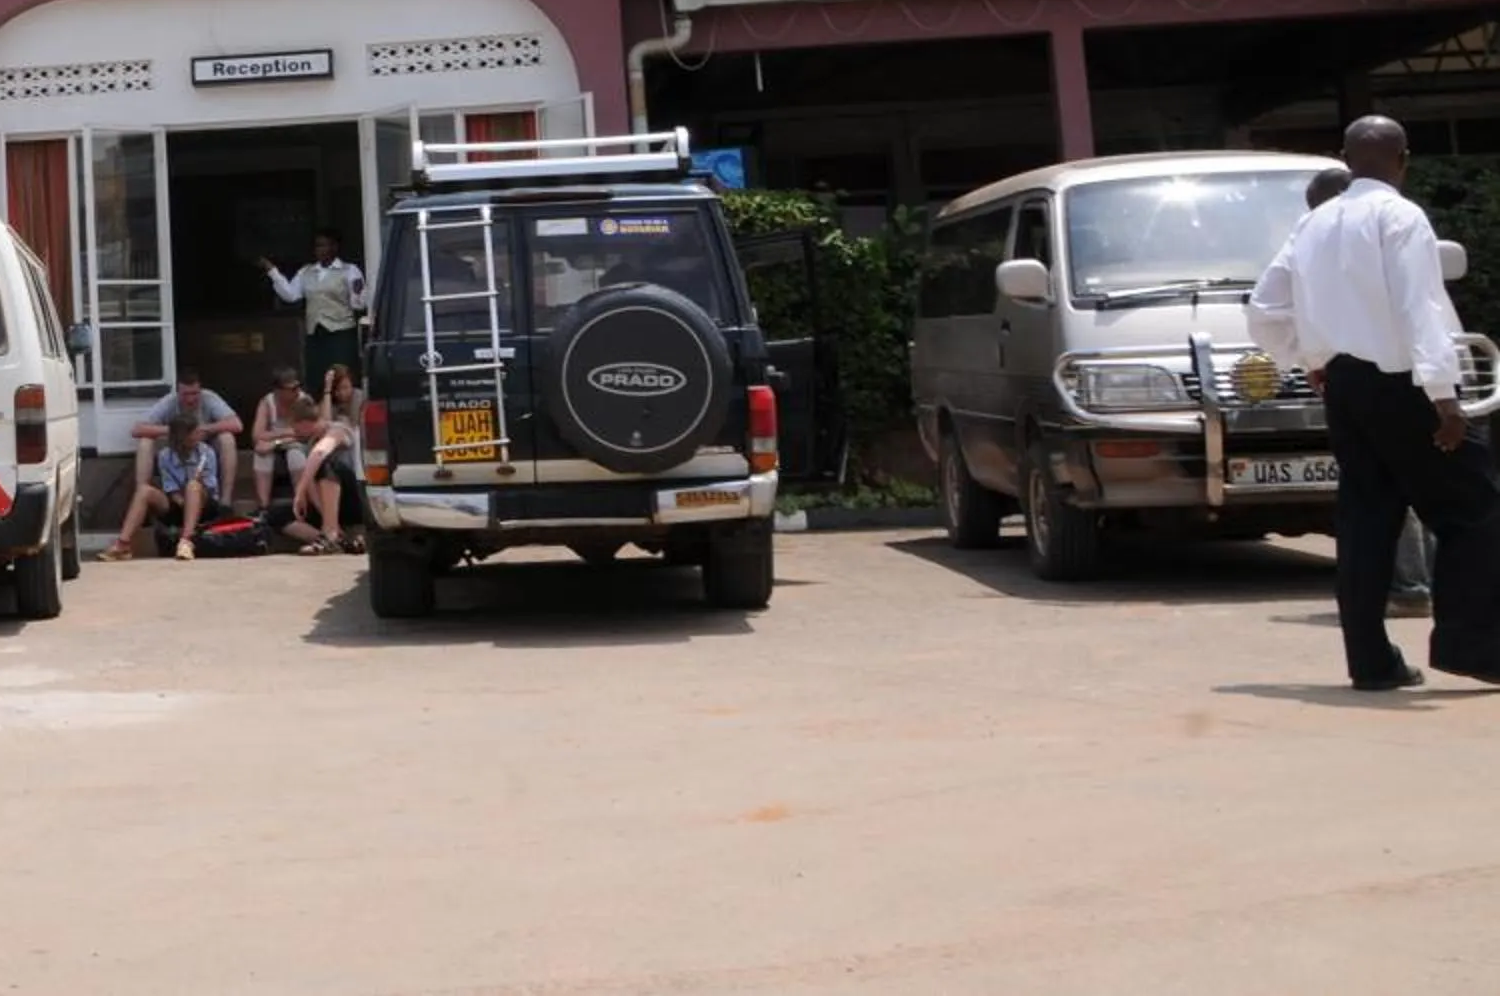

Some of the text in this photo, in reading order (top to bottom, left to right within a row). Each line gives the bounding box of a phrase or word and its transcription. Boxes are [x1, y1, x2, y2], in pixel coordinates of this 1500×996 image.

[212, 60, 312, 77] Reception
[600, 372, 675, 387] PRADO
[453, 412, 490, 434] UAH
[1253, 461, 1292, 484] UAS
